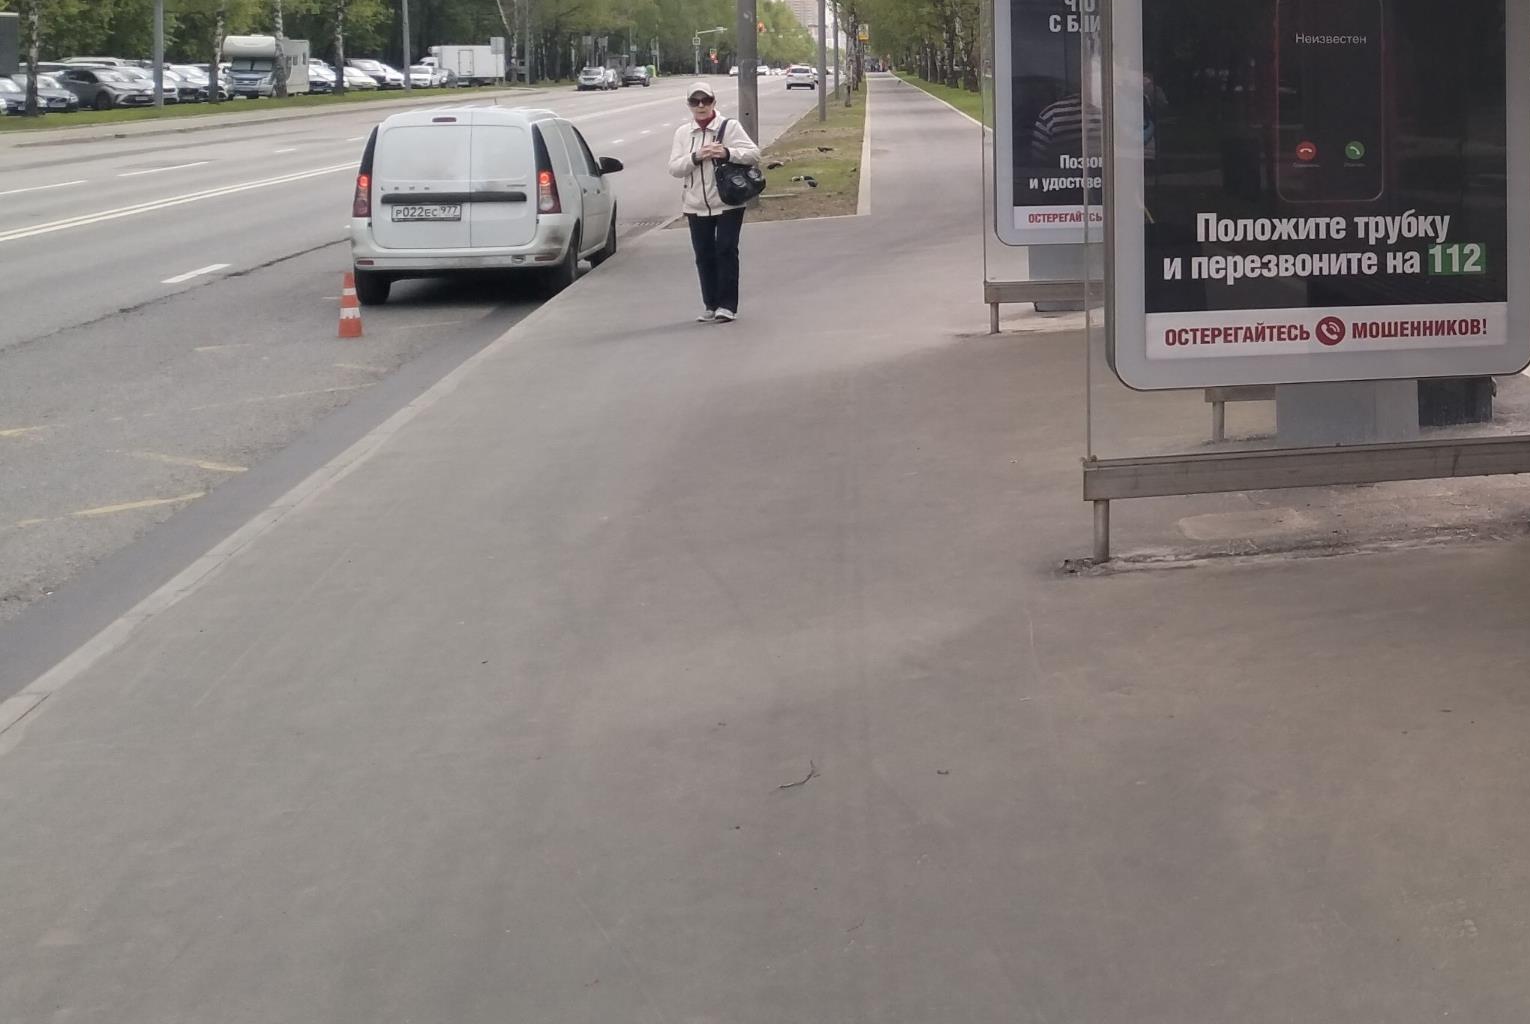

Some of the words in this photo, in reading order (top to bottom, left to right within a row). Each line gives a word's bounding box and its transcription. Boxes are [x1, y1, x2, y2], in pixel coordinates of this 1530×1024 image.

[1048, 14, 1062, 33] С
[1295, 32, 1367, 45] Неизвестен
[1029, 178, 1039, 190] и
[1028, 210, 1103, 224] ОСТЕРЕГАЙСЬ
[1196, 212, 1346, 242] Положите
[1354, 209, 1450, 245] трубку
[1163, 257, 1182, 280] и
[1191, 250, 1378, 285] перезвоните
[1386, 250, 1421, 274] на
[1429, 243, 1482, 273] 112
[1164, 322, 1311, 347] ОСТЕРЕГАЙТЕСЬ
[1352, 318, 1488, 340] МОШЕННИКОВ!
